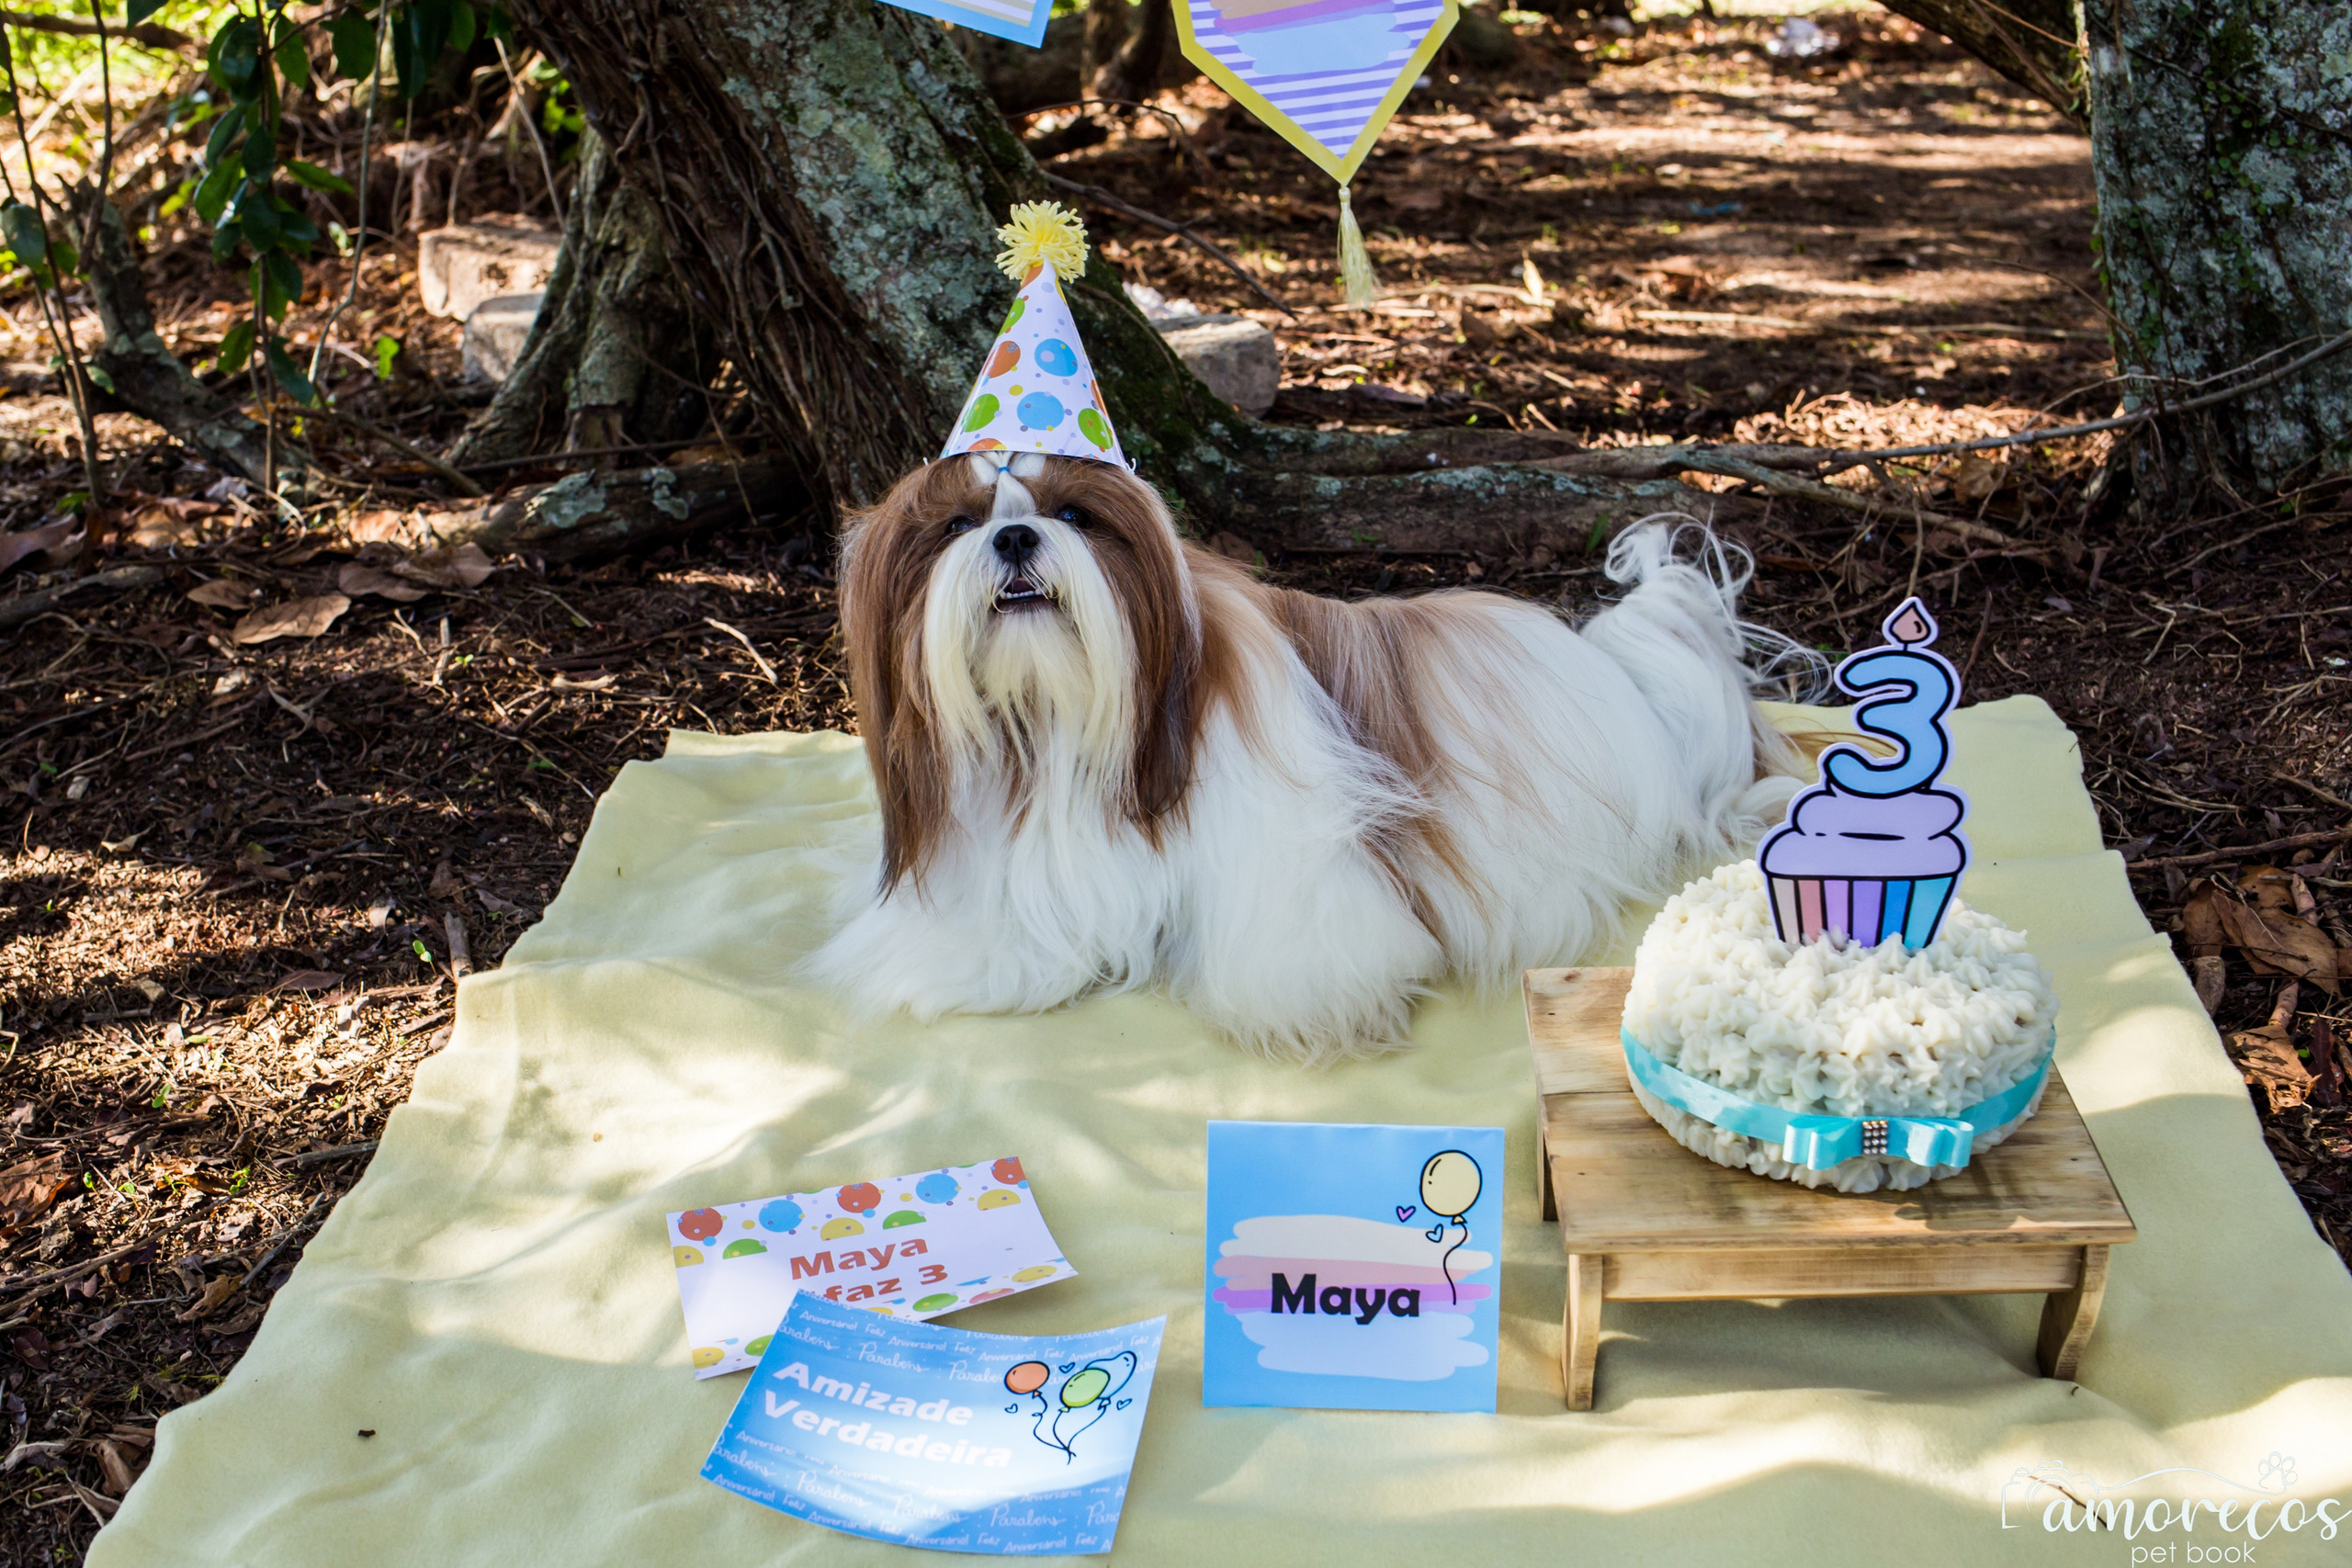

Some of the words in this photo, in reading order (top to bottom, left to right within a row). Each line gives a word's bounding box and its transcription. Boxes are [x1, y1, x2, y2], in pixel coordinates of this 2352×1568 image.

[1823, 649, 1954, 799] 3
[790, 1238, 929, 1280] Maya
[823, 1277, 902, 1303] faz
[918, 1264, 948, 1285] 3
[1271, 1272, 1420, 1325] Maya
[773, 1361, 973, 1426] Amizade
[765, 1389, 1012, 1468] Verdadeira
